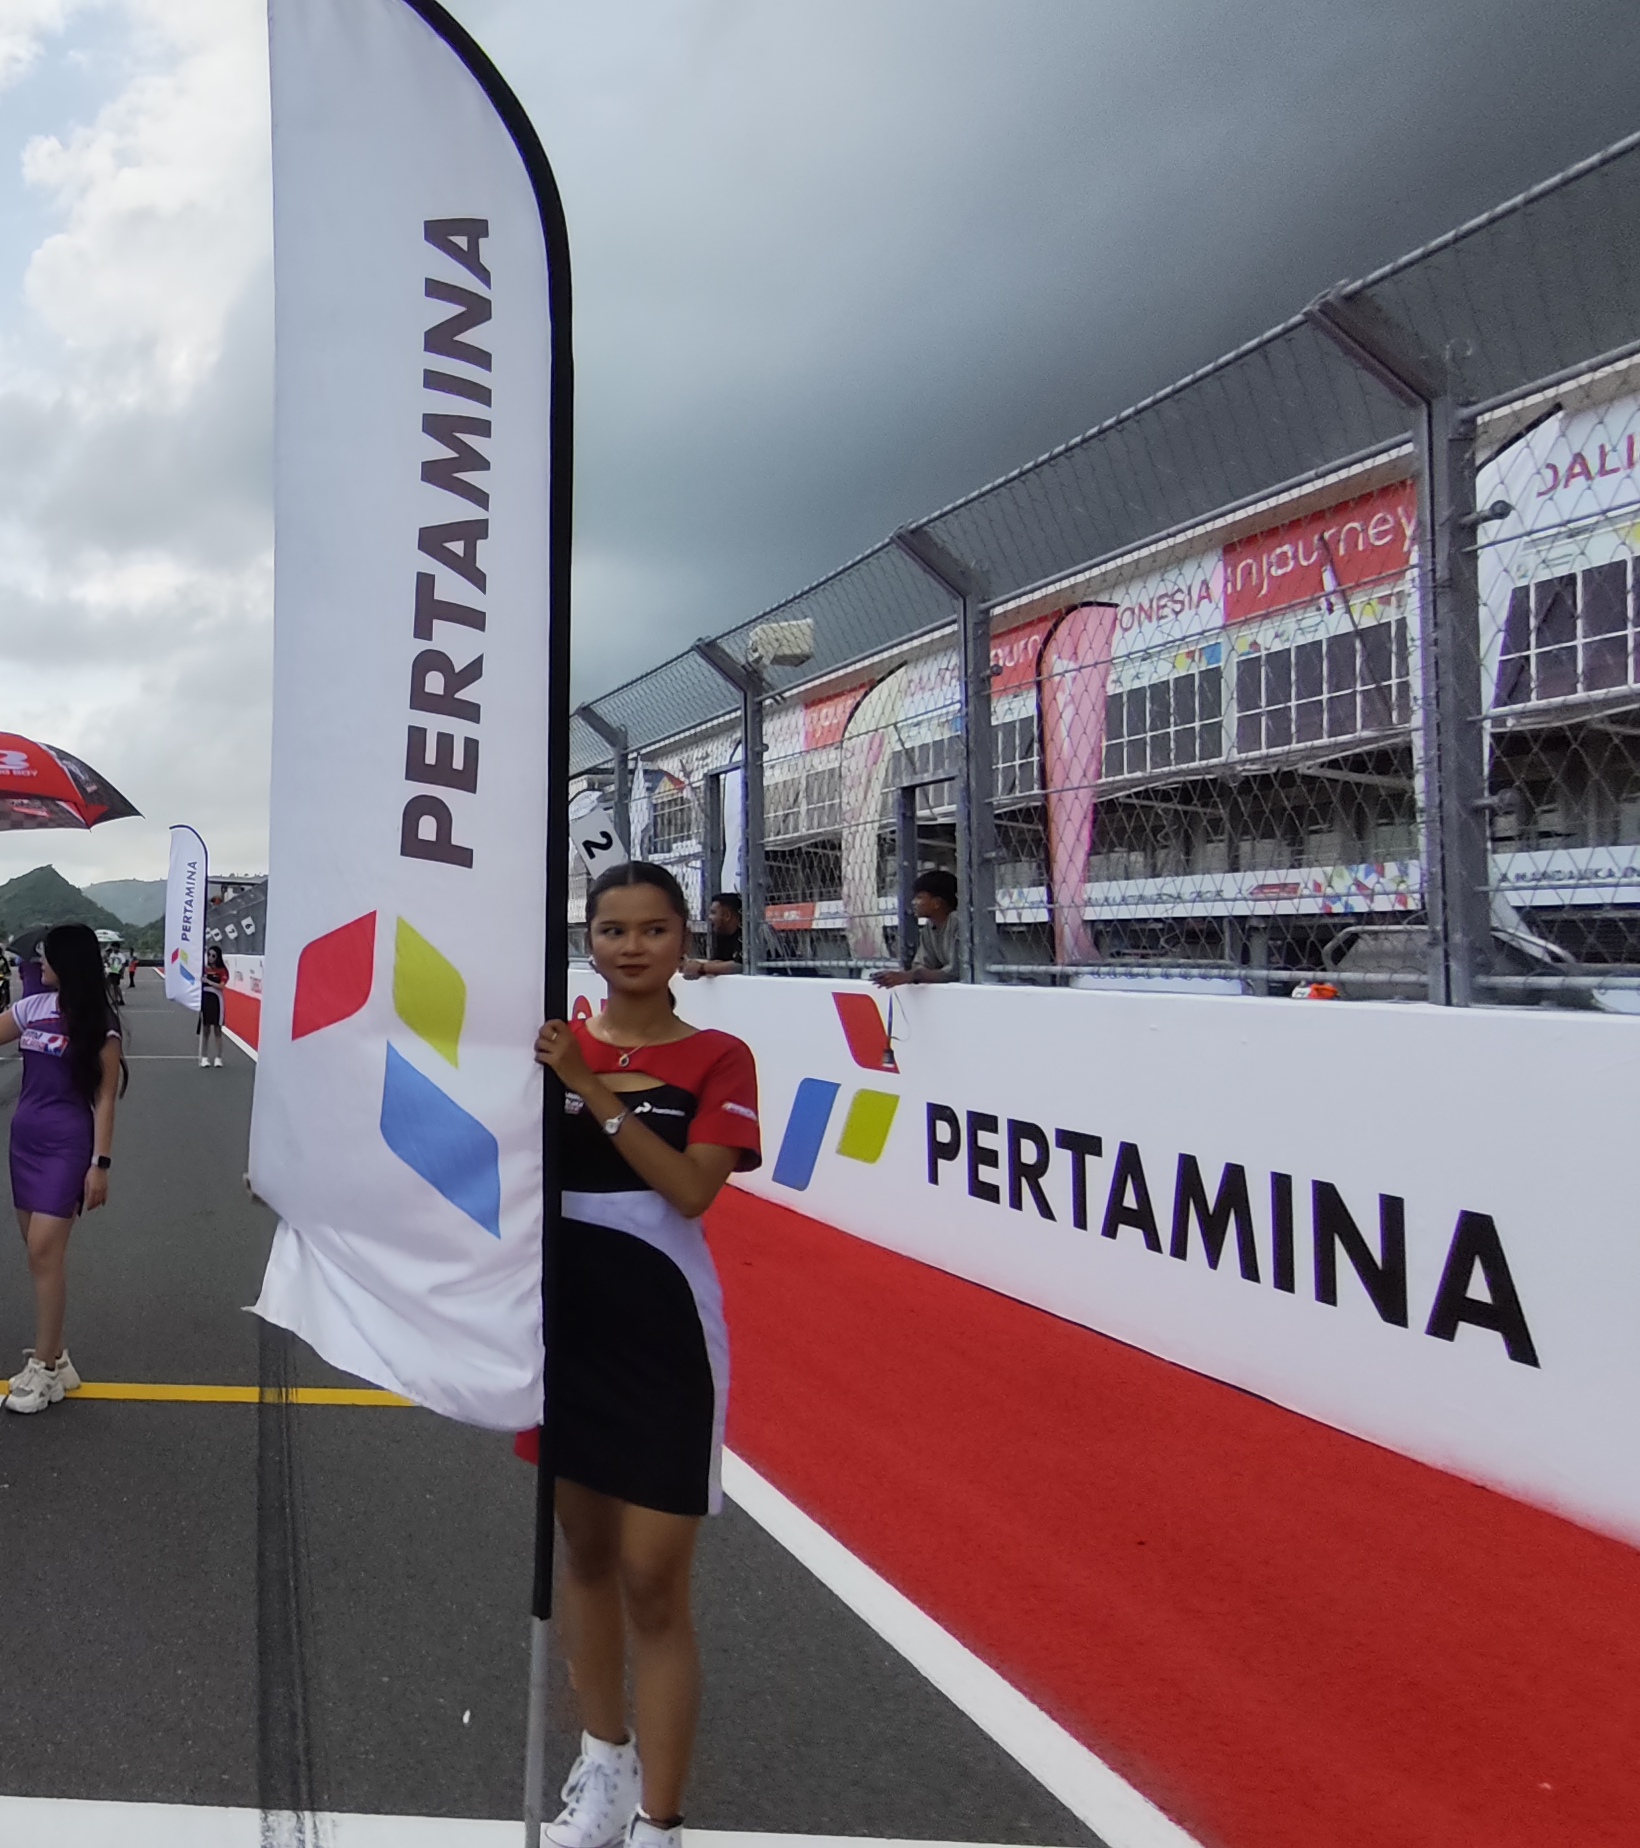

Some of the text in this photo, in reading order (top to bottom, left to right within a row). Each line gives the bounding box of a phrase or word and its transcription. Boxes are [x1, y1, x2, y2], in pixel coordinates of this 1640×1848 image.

[400, 217, 492, 869] PERTAMINA
[12, 769, 38, 777] BOY
[582, 830, 613, 860] 2
[181, 861, 198, 942] PERTAMINA
[925, 1102, 1542, 1369] PERTAMINA
